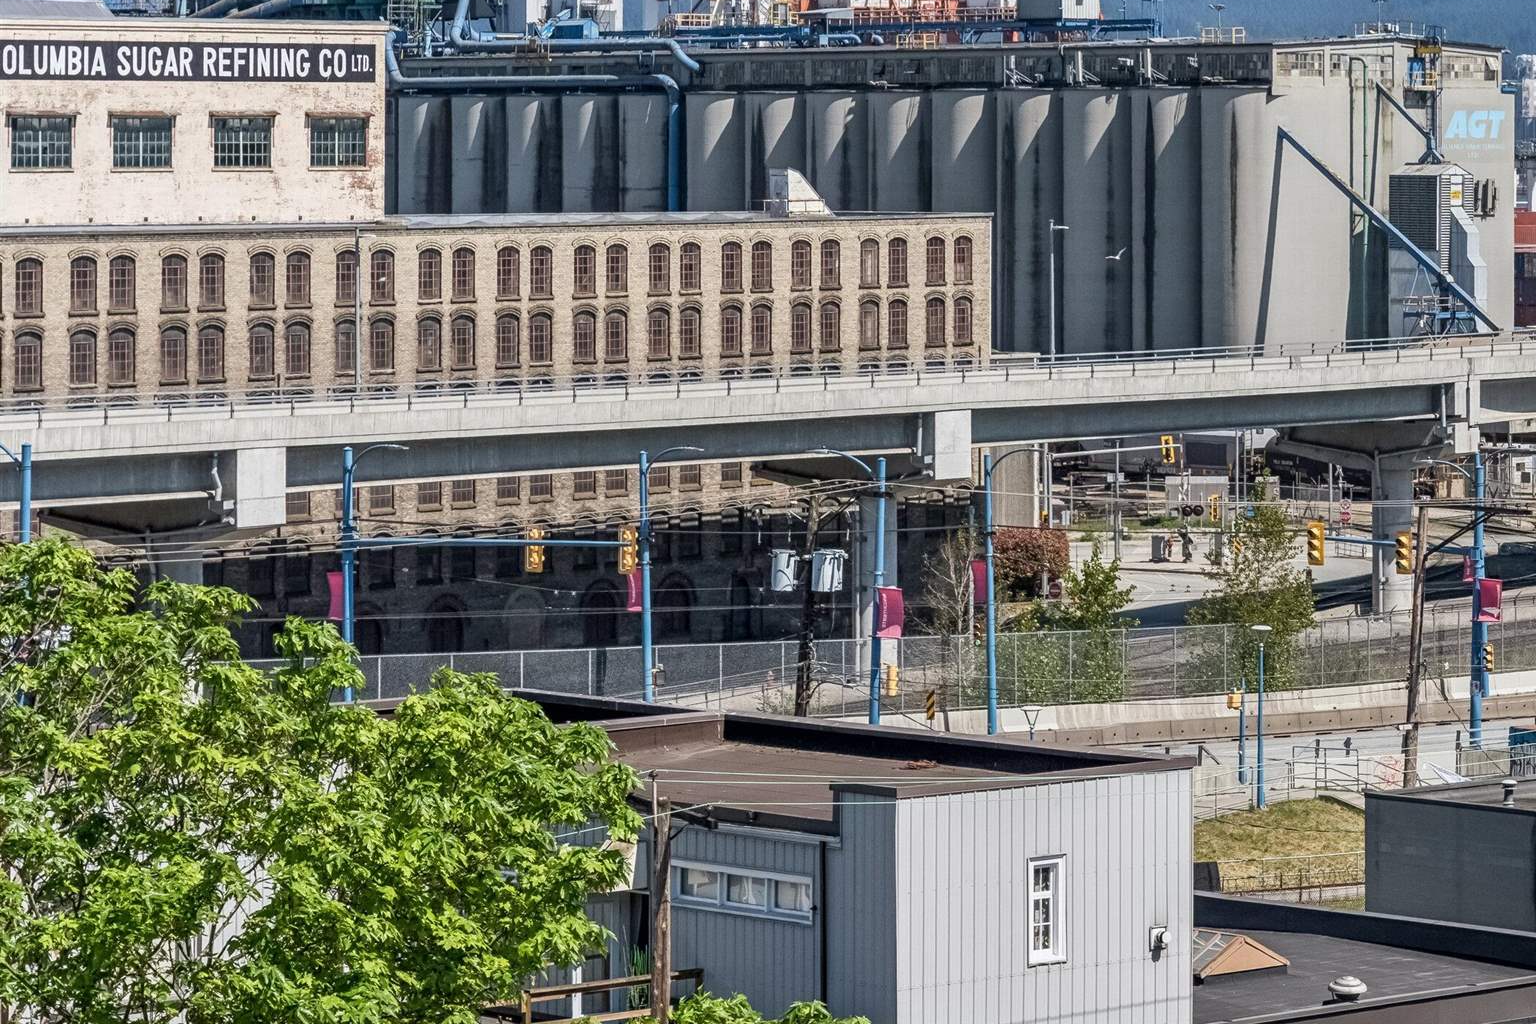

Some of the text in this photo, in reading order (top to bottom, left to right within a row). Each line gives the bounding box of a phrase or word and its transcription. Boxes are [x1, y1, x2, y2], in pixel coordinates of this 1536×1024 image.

[2, 45, 373, 78] OLUMBIA SUGAR REFINING CO LTD.
[1445, 110, 1504, 138] AGT
